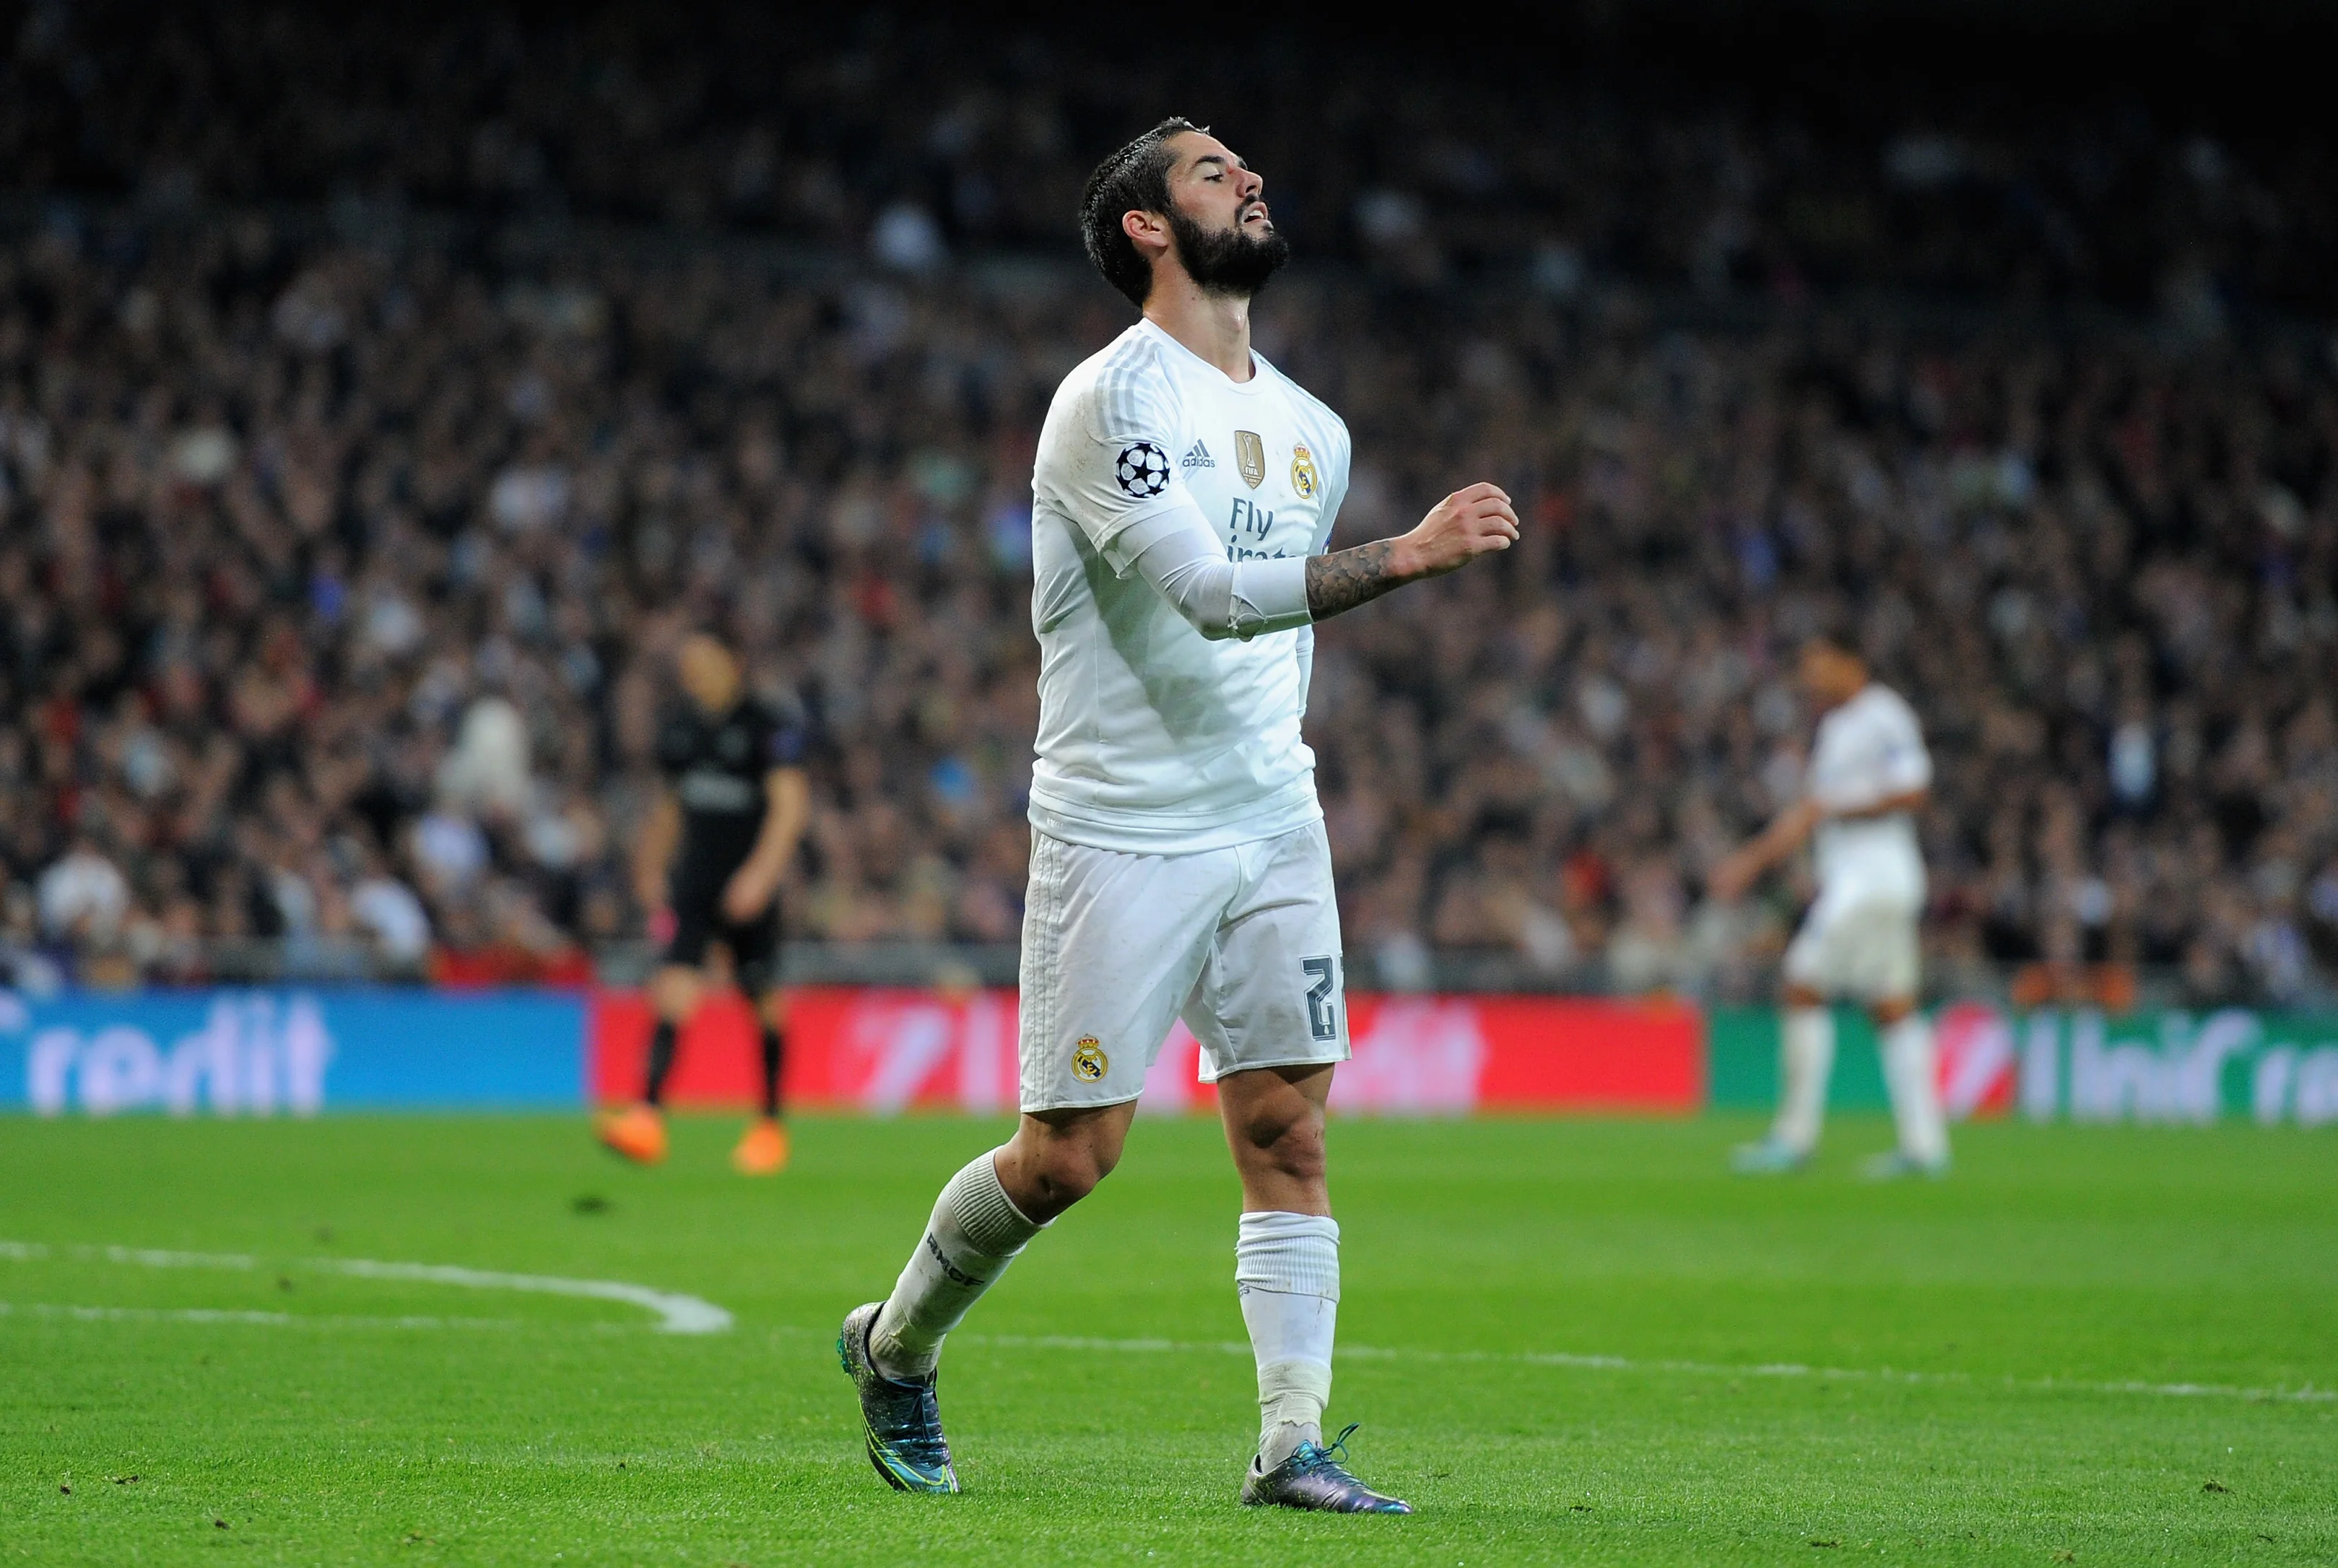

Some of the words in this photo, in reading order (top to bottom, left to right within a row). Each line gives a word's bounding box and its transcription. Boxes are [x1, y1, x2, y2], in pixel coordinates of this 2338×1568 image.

[1182, 456, 1215, 468] adidas
[1245, 466, 1259, 476] FIFA
[1230, 497, 1274, 541] Fly
[1300, 954, 1344, 1041] 2
[0, 989, 335, 1119] redit
